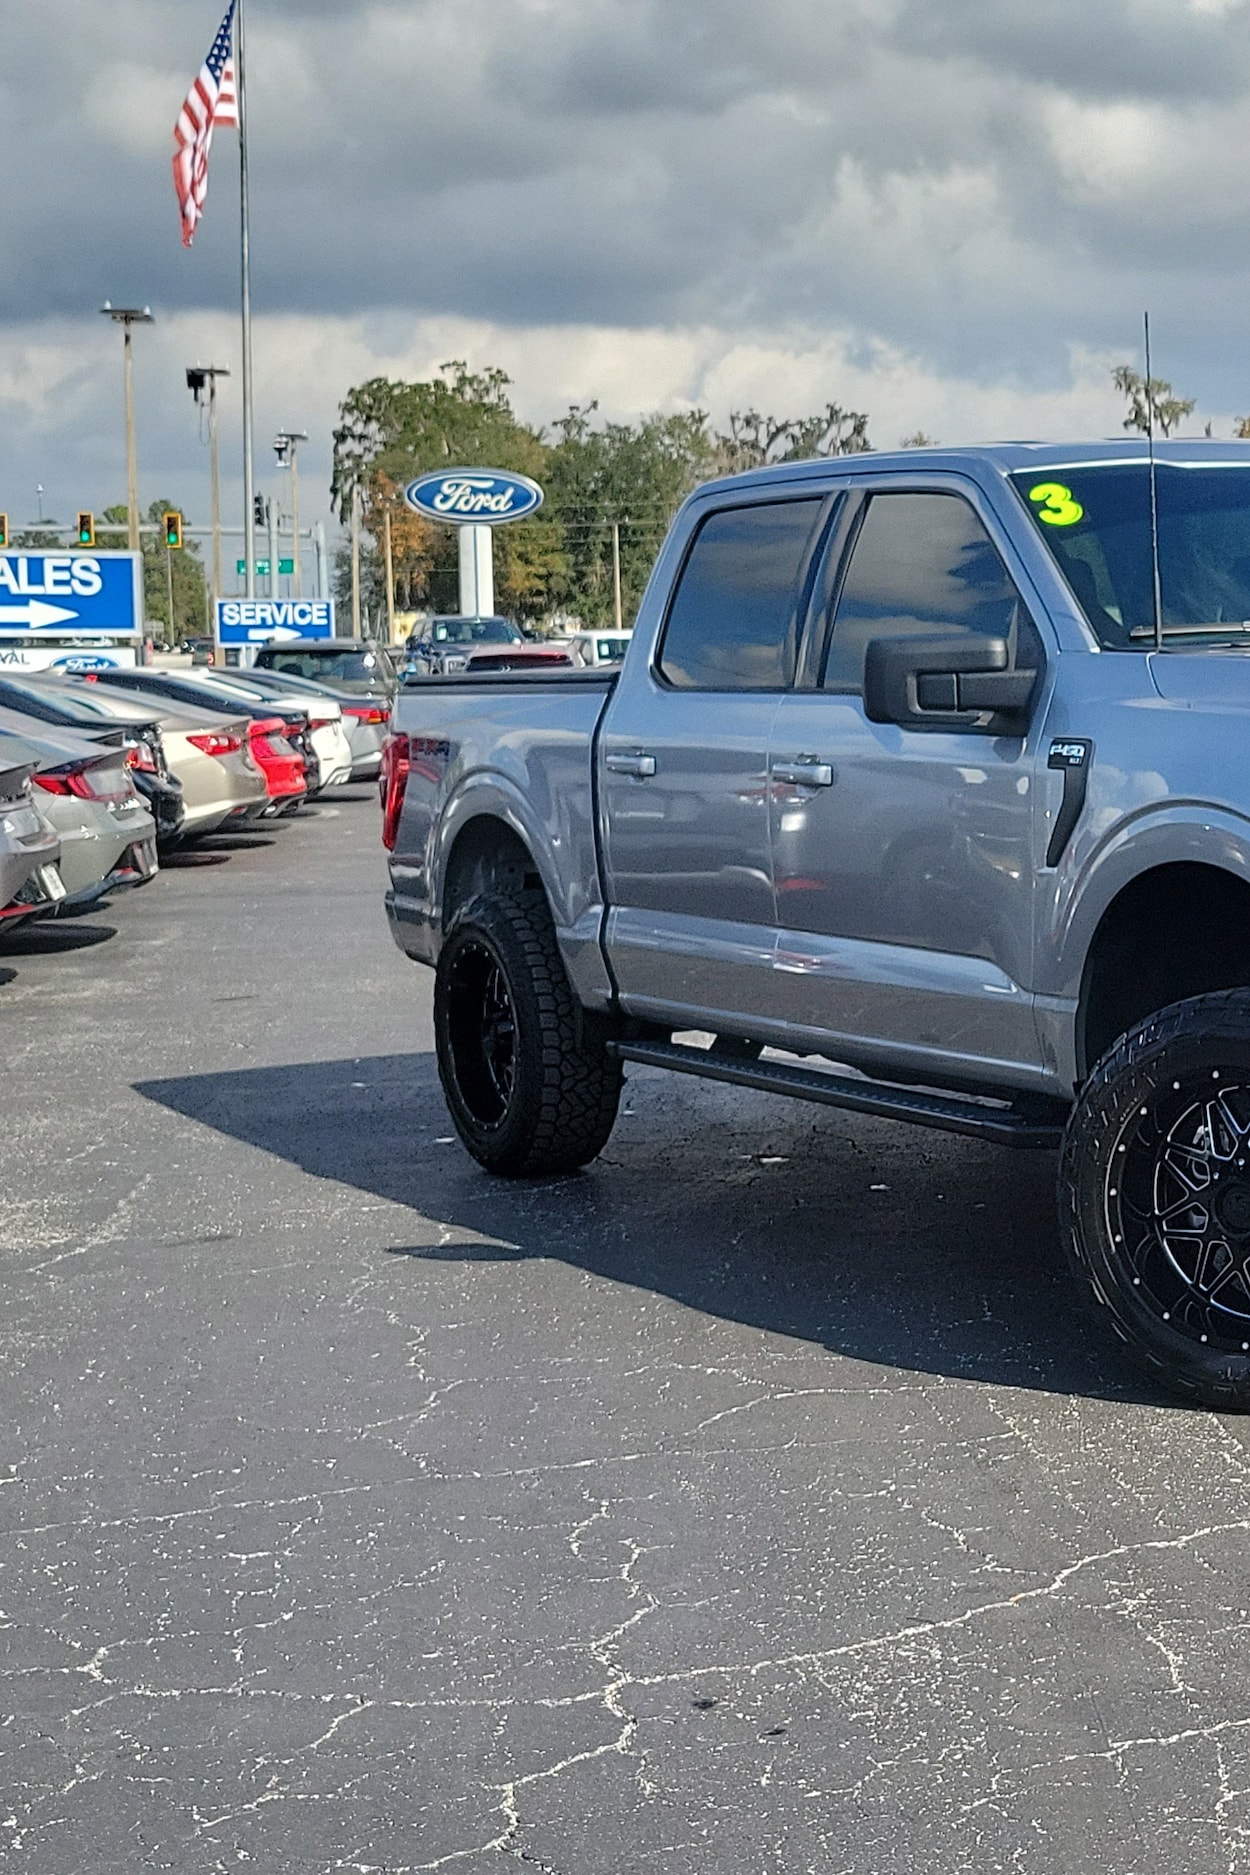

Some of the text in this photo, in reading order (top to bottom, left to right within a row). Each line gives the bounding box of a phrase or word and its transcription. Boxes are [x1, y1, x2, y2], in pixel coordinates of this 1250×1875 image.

[434, 479, 514, 512] Ford
[1029, 483, 1083, 526] 3
[222, 603, 328, 626] SERVICE
